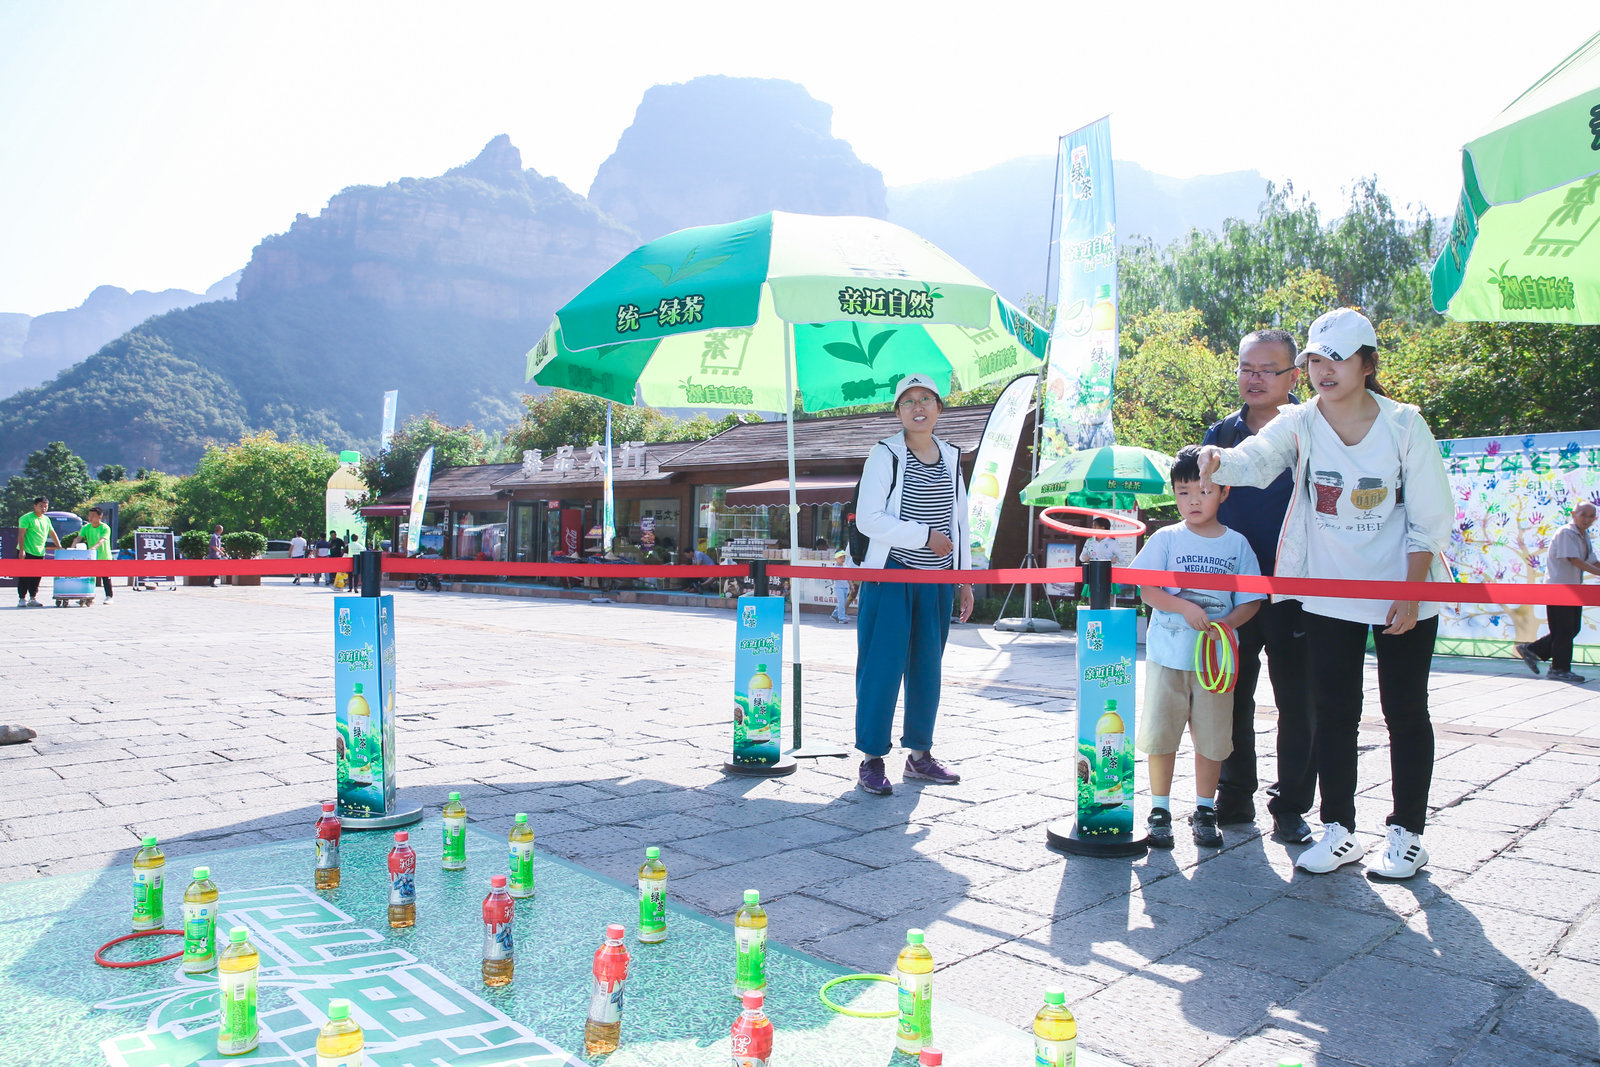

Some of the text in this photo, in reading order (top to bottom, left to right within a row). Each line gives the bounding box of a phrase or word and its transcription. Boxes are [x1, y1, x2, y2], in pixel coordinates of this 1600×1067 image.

[1071, 162, 1092, 199] 绿茶
[616, 294, 705, 333] 统一绿茶
[839, 286, 934, 318] 亲近自然
[1091, 347, 1110, 378] 绿茶
[1176, 555, 1235, 572] CARCHAROCLES
[1086, 628, 1103, 651] 绿茶
[1085, 663, 1125, 681] 亲近自然
[353, 726, 367, 750] 绿茶
[1102, 746, 1118, 769] 绿茶
[651, 891, 664, 912] 绿茶
